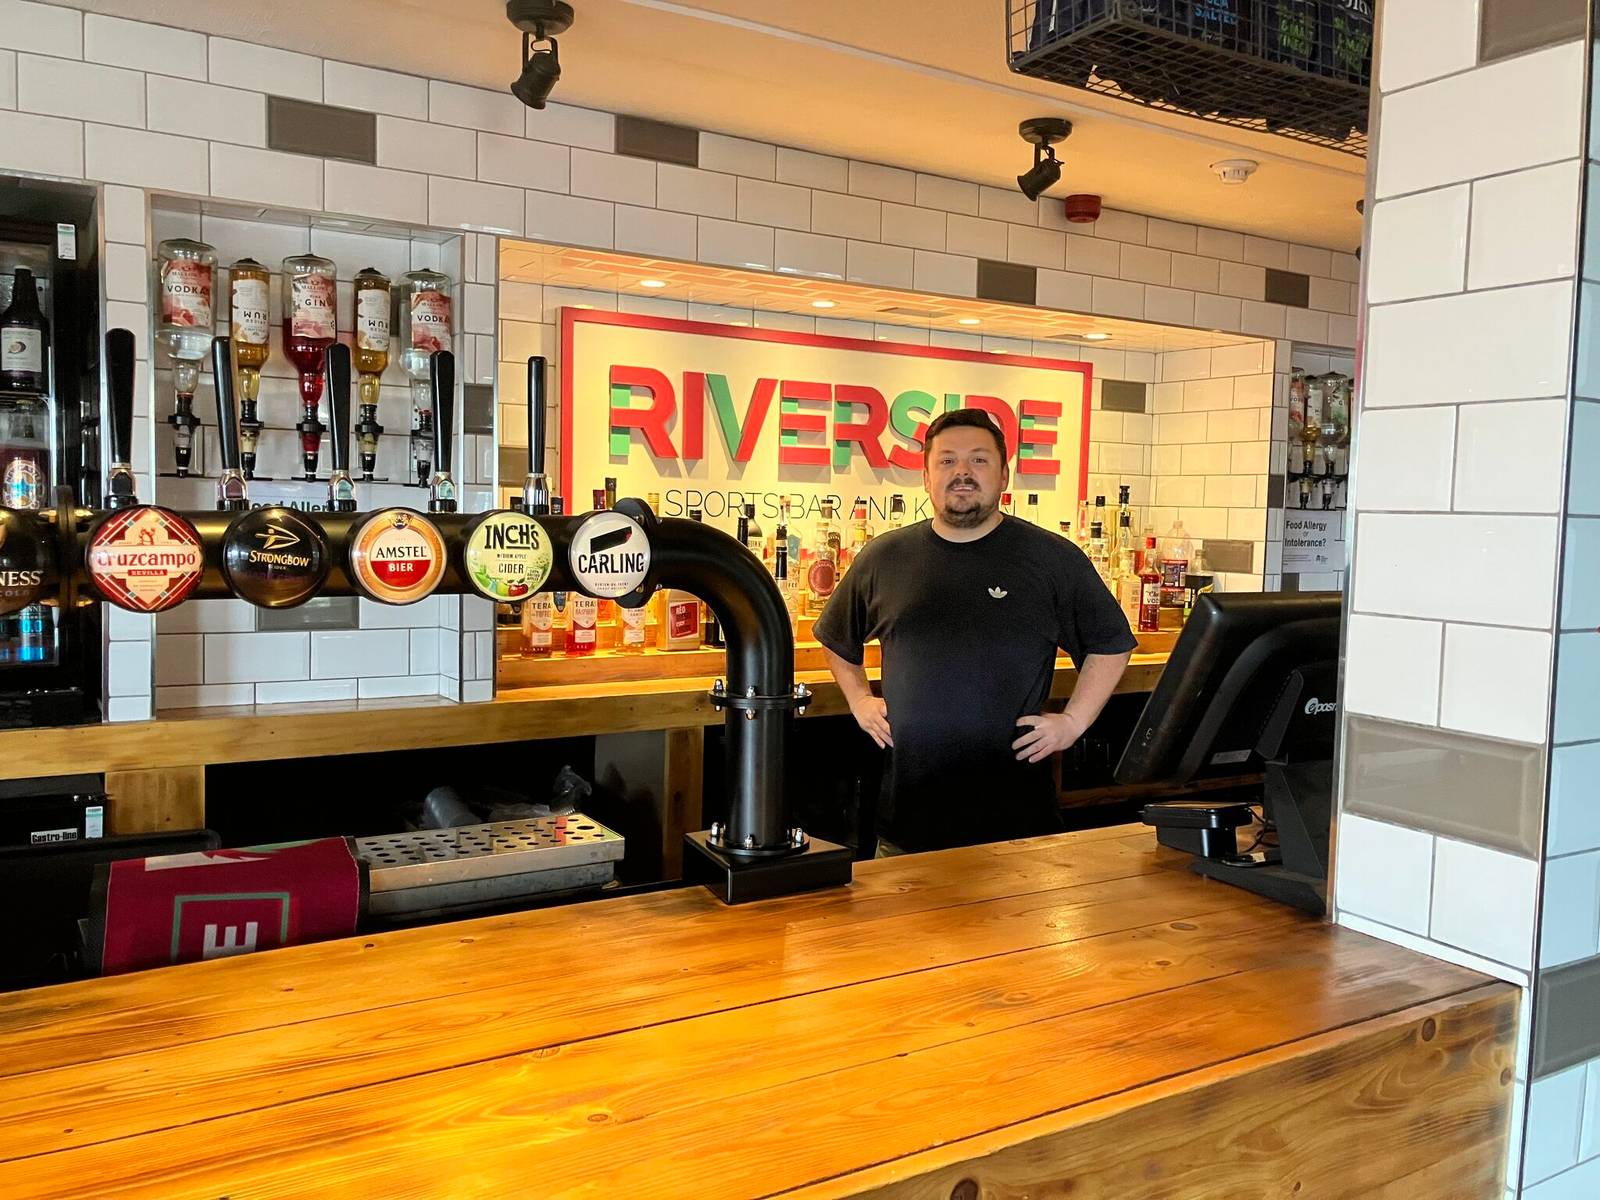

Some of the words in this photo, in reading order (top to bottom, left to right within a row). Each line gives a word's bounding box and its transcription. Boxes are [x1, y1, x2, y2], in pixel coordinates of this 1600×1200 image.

[167, 285, 209, 296] VODKA
[305, 299, 326, 307] GIN
[243, 310, 267, 321] RUM
[664, 489, 779, 519] SPORTS
[1285, 520, 1303, 530] Food
[1303, 520, 1328, 532] Allergy
[484, 523, 539, 550] INCH'S
[1284, 538, 1327, 547] Intolerance?
[375, 546, 427, 558] AMSTEL
[96, 550, 196, 568] Cruzcampo
[249, 550, 310, 567] STRONGBOW
[578, 552, 645, 574] CARLING
[388, 562, 414, 572] BIER
[498, 563, 525, 574] CIDER
